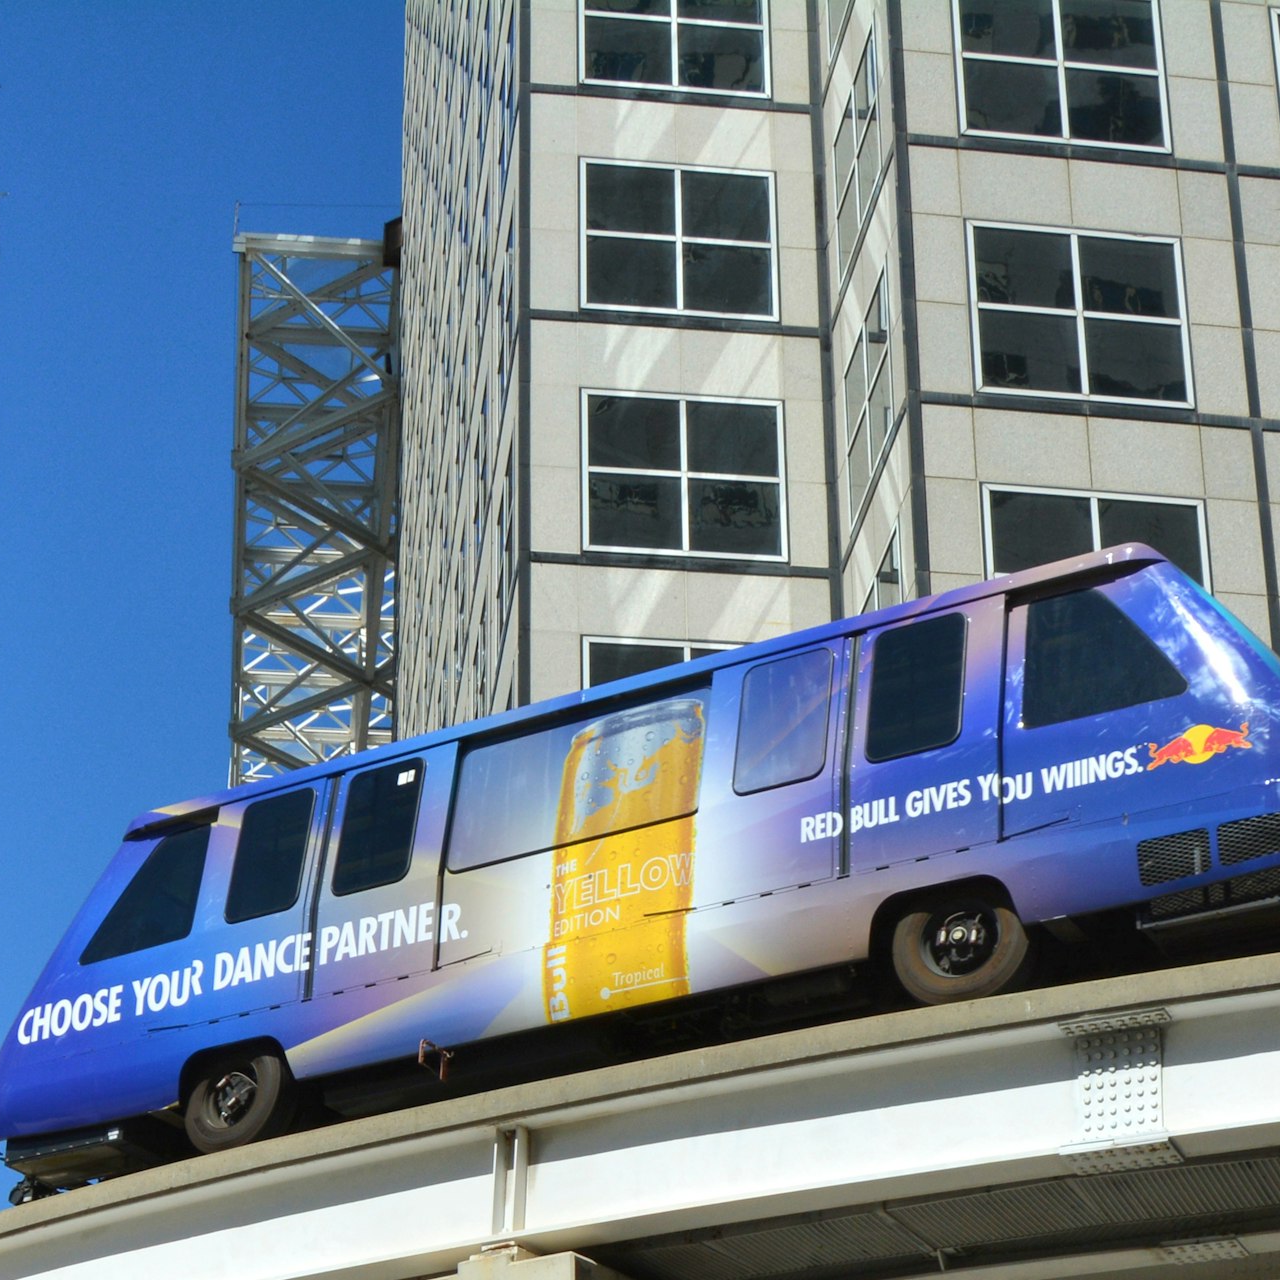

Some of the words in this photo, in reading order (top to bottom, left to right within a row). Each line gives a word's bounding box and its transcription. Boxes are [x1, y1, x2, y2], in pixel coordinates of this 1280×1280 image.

[800, 811, 844, 843] RED
[850, 796, 900, 833] BULL
[905, 779, 972, 818] GIVES
[977, 772, 1033, 805] YOU
[1041, 745, 1144, 794] WIIINGS.
[554, 853, 694, 914] YELLOW
[555, 859, 577, 877] THE
[554, 905, 620, 938] EDITION
[17, 984, 124, 1045] CHOOSE
[132, 959, 204, 1016] YOUR
[213, 931, 313, 991] DANCE
[319, 901, 469, 966] PARTNER.
[547, 944, 571, 1022] Bull
[612, 963, 665, 987] Tropical
